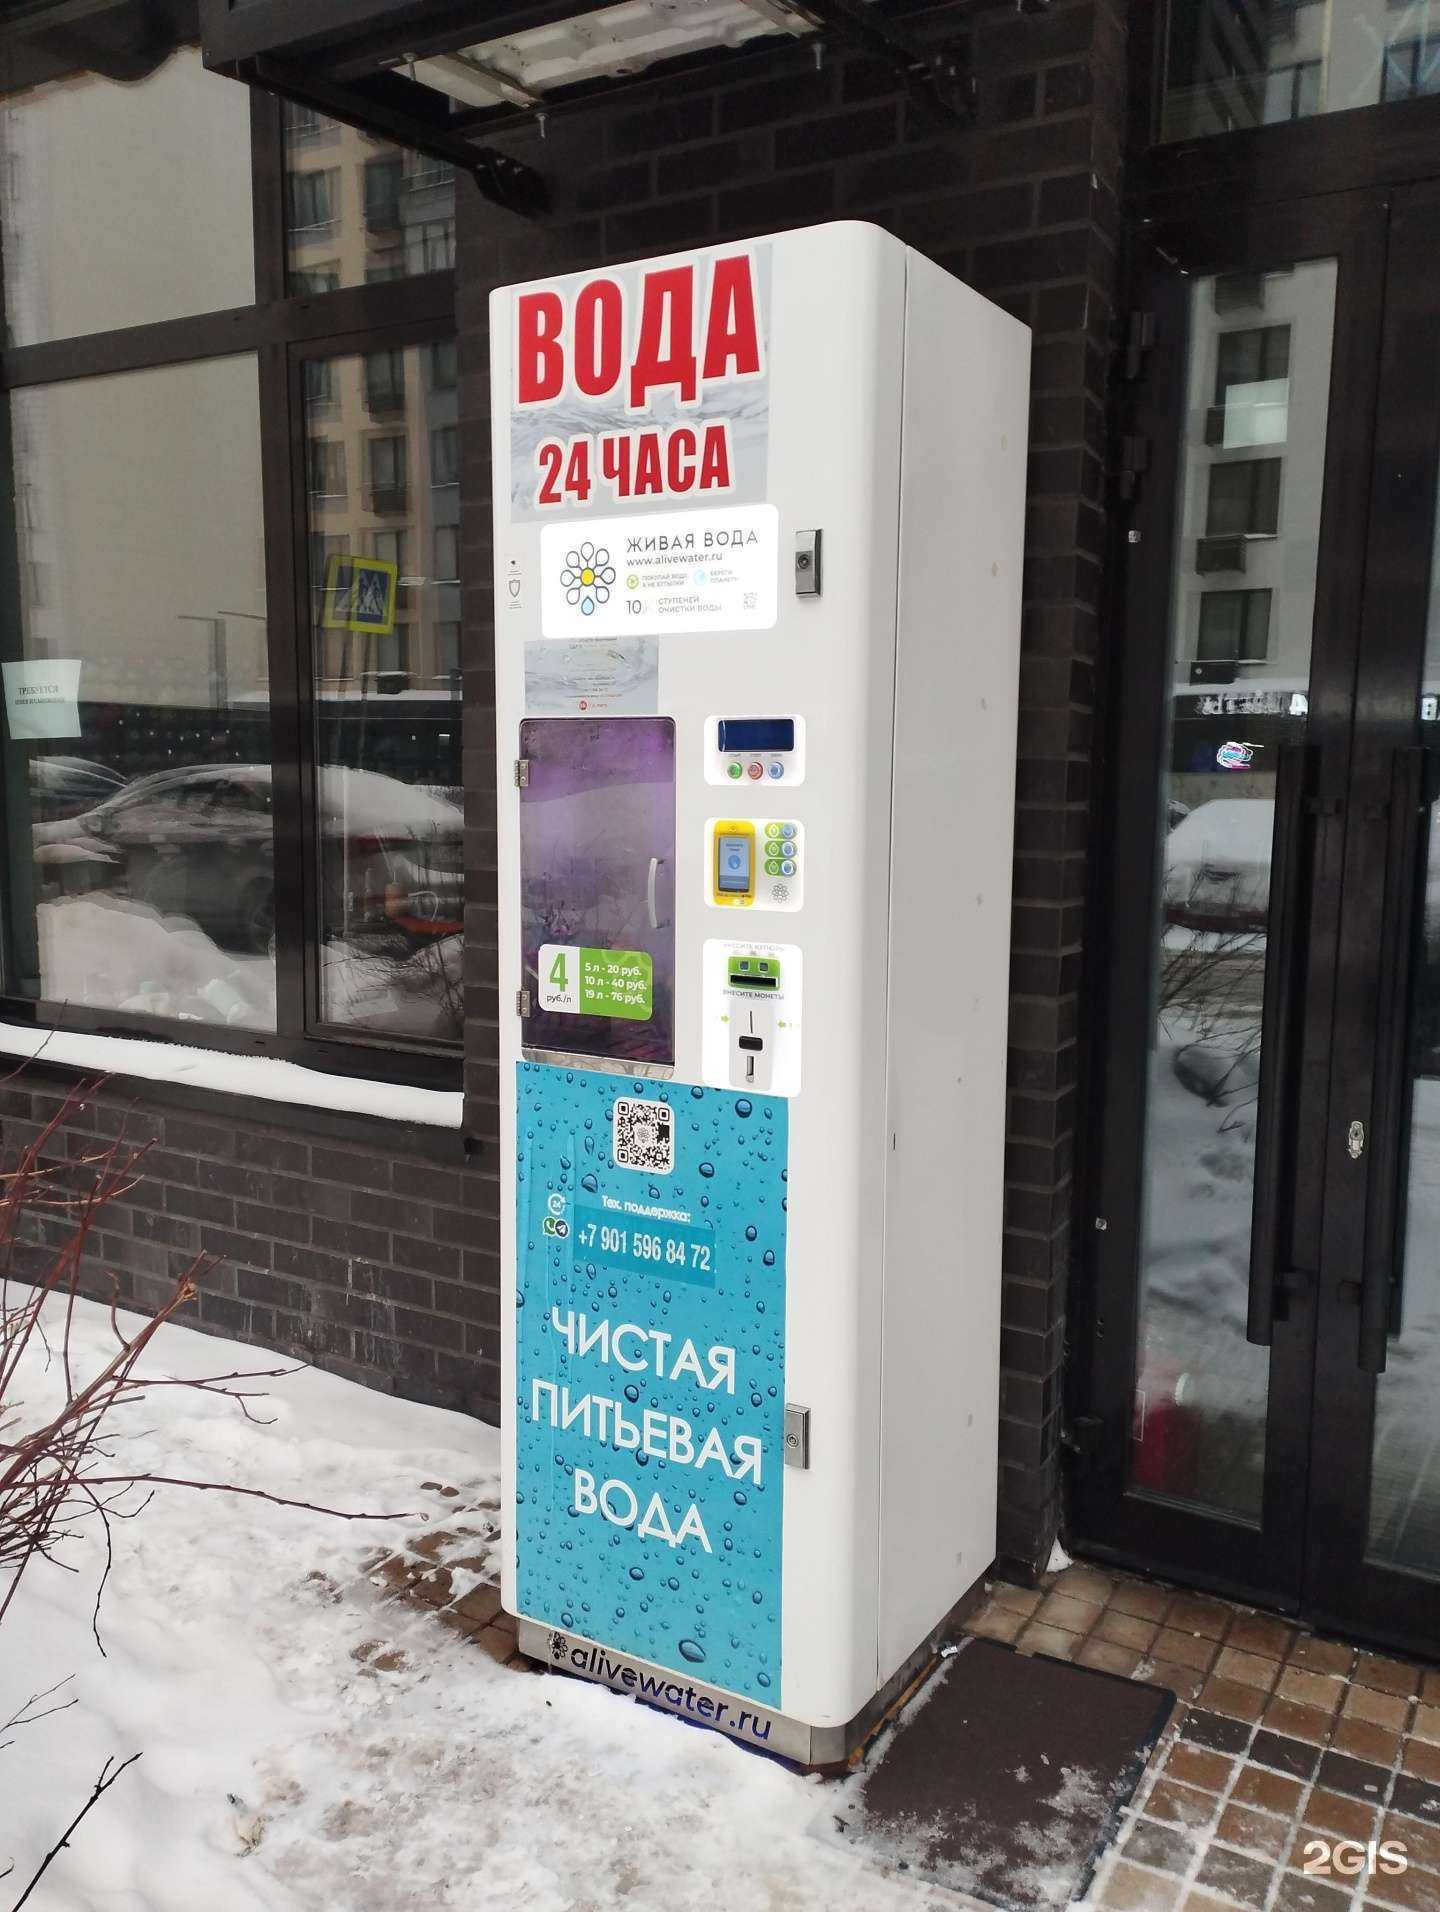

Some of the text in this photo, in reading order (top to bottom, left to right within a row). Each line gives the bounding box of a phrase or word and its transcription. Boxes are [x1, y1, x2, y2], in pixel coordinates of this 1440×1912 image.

[519, 255, 760, 408] ВОДА
[539, 425, 730, 504] 24 ЧАСА
[627, 530, 759, 553] ЖИВАЯ ВОДА
[626, 552, 723, 567] www.alivewater.ru
[658, 596, 700, 605] СТУПЕНЕЙ
[658, 604, 696, 614] ОЧИСТКИ
[549, 953, 569, 992] 4
[585, 963, 592, 972] 5
[593, 964, 600, 972] л
[607, 965, 619, 973] 20
[621, 966, 642, 976] руб.
[585, 976, 595, 985] 10
[596, 978, 604, 986] л
[611, 978, 624, 987] 40
[626, 980, 647, 990] руб.
[723, 989, 785, 1000] ВНЕСИТЕ МОНЕТЫ
[547, 994, 572, 1004] руб./л
[585, 989, 595, 999] 19
[612, 992, 623, 1001] 76
[624, 994, 646, 1004] руб.
[602, 1195, 691, 1223] Тех. поддержка:
[579, 1223, 711, 1271] +7 901 596 84 72
[551, 1306, 736, 1395] ЧИСТАЯ
[532, 1378, 762, 1485] ПИТЬЕВАЯ
[574, 1468, 713, 1554] ВОДА
[571, 1647, 771, 1740] alivewater.ru
